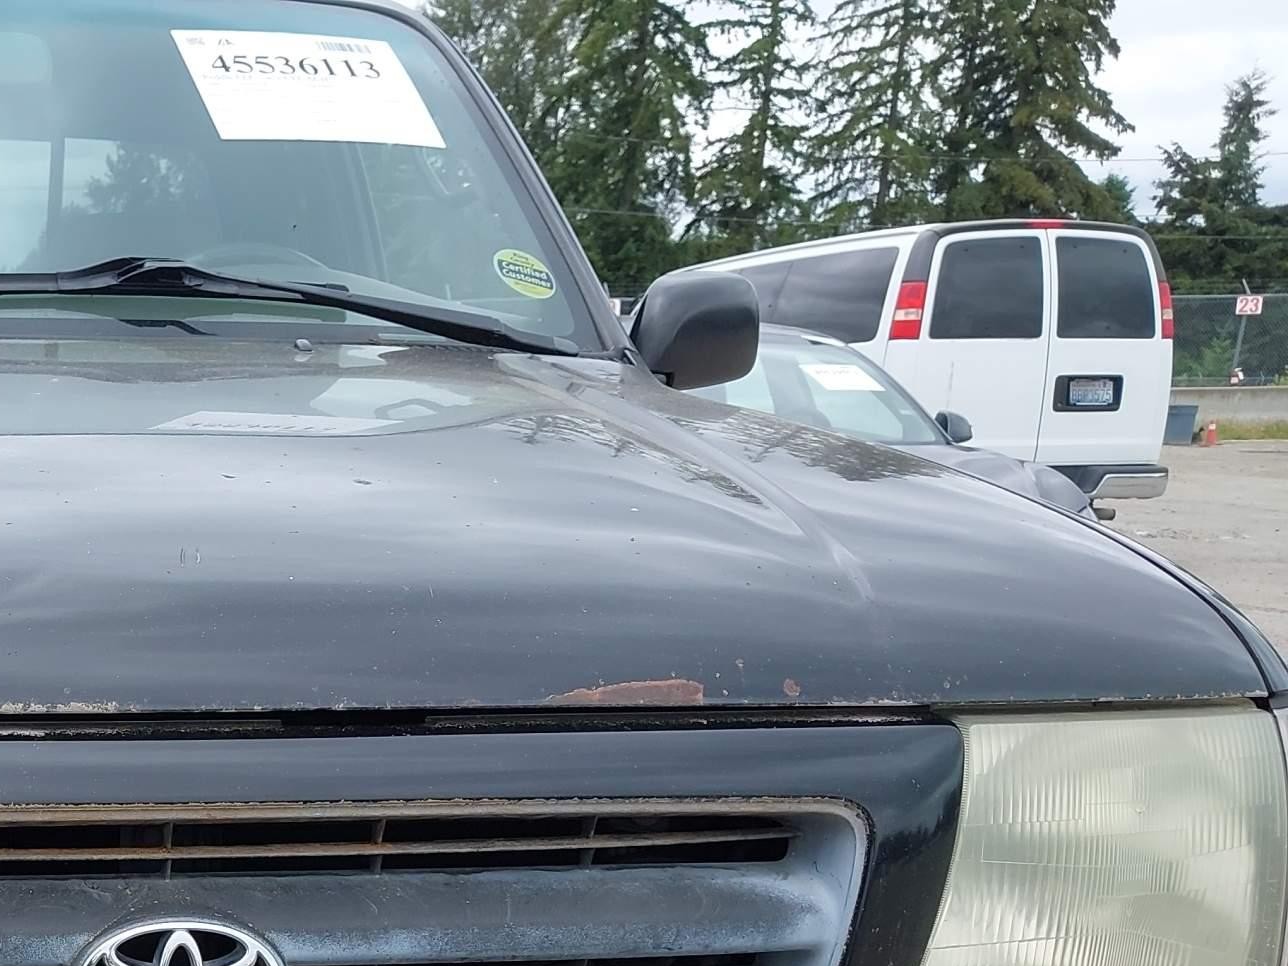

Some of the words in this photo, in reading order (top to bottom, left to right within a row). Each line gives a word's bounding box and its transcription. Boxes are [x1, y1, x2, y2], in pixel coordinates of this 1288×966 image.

[211, 54, 382, 79] 45536113
[501, 261, 548, 280] Certified
[502, 268, 552, 288] Customer
[1238, 297, 1260, 313] 23
